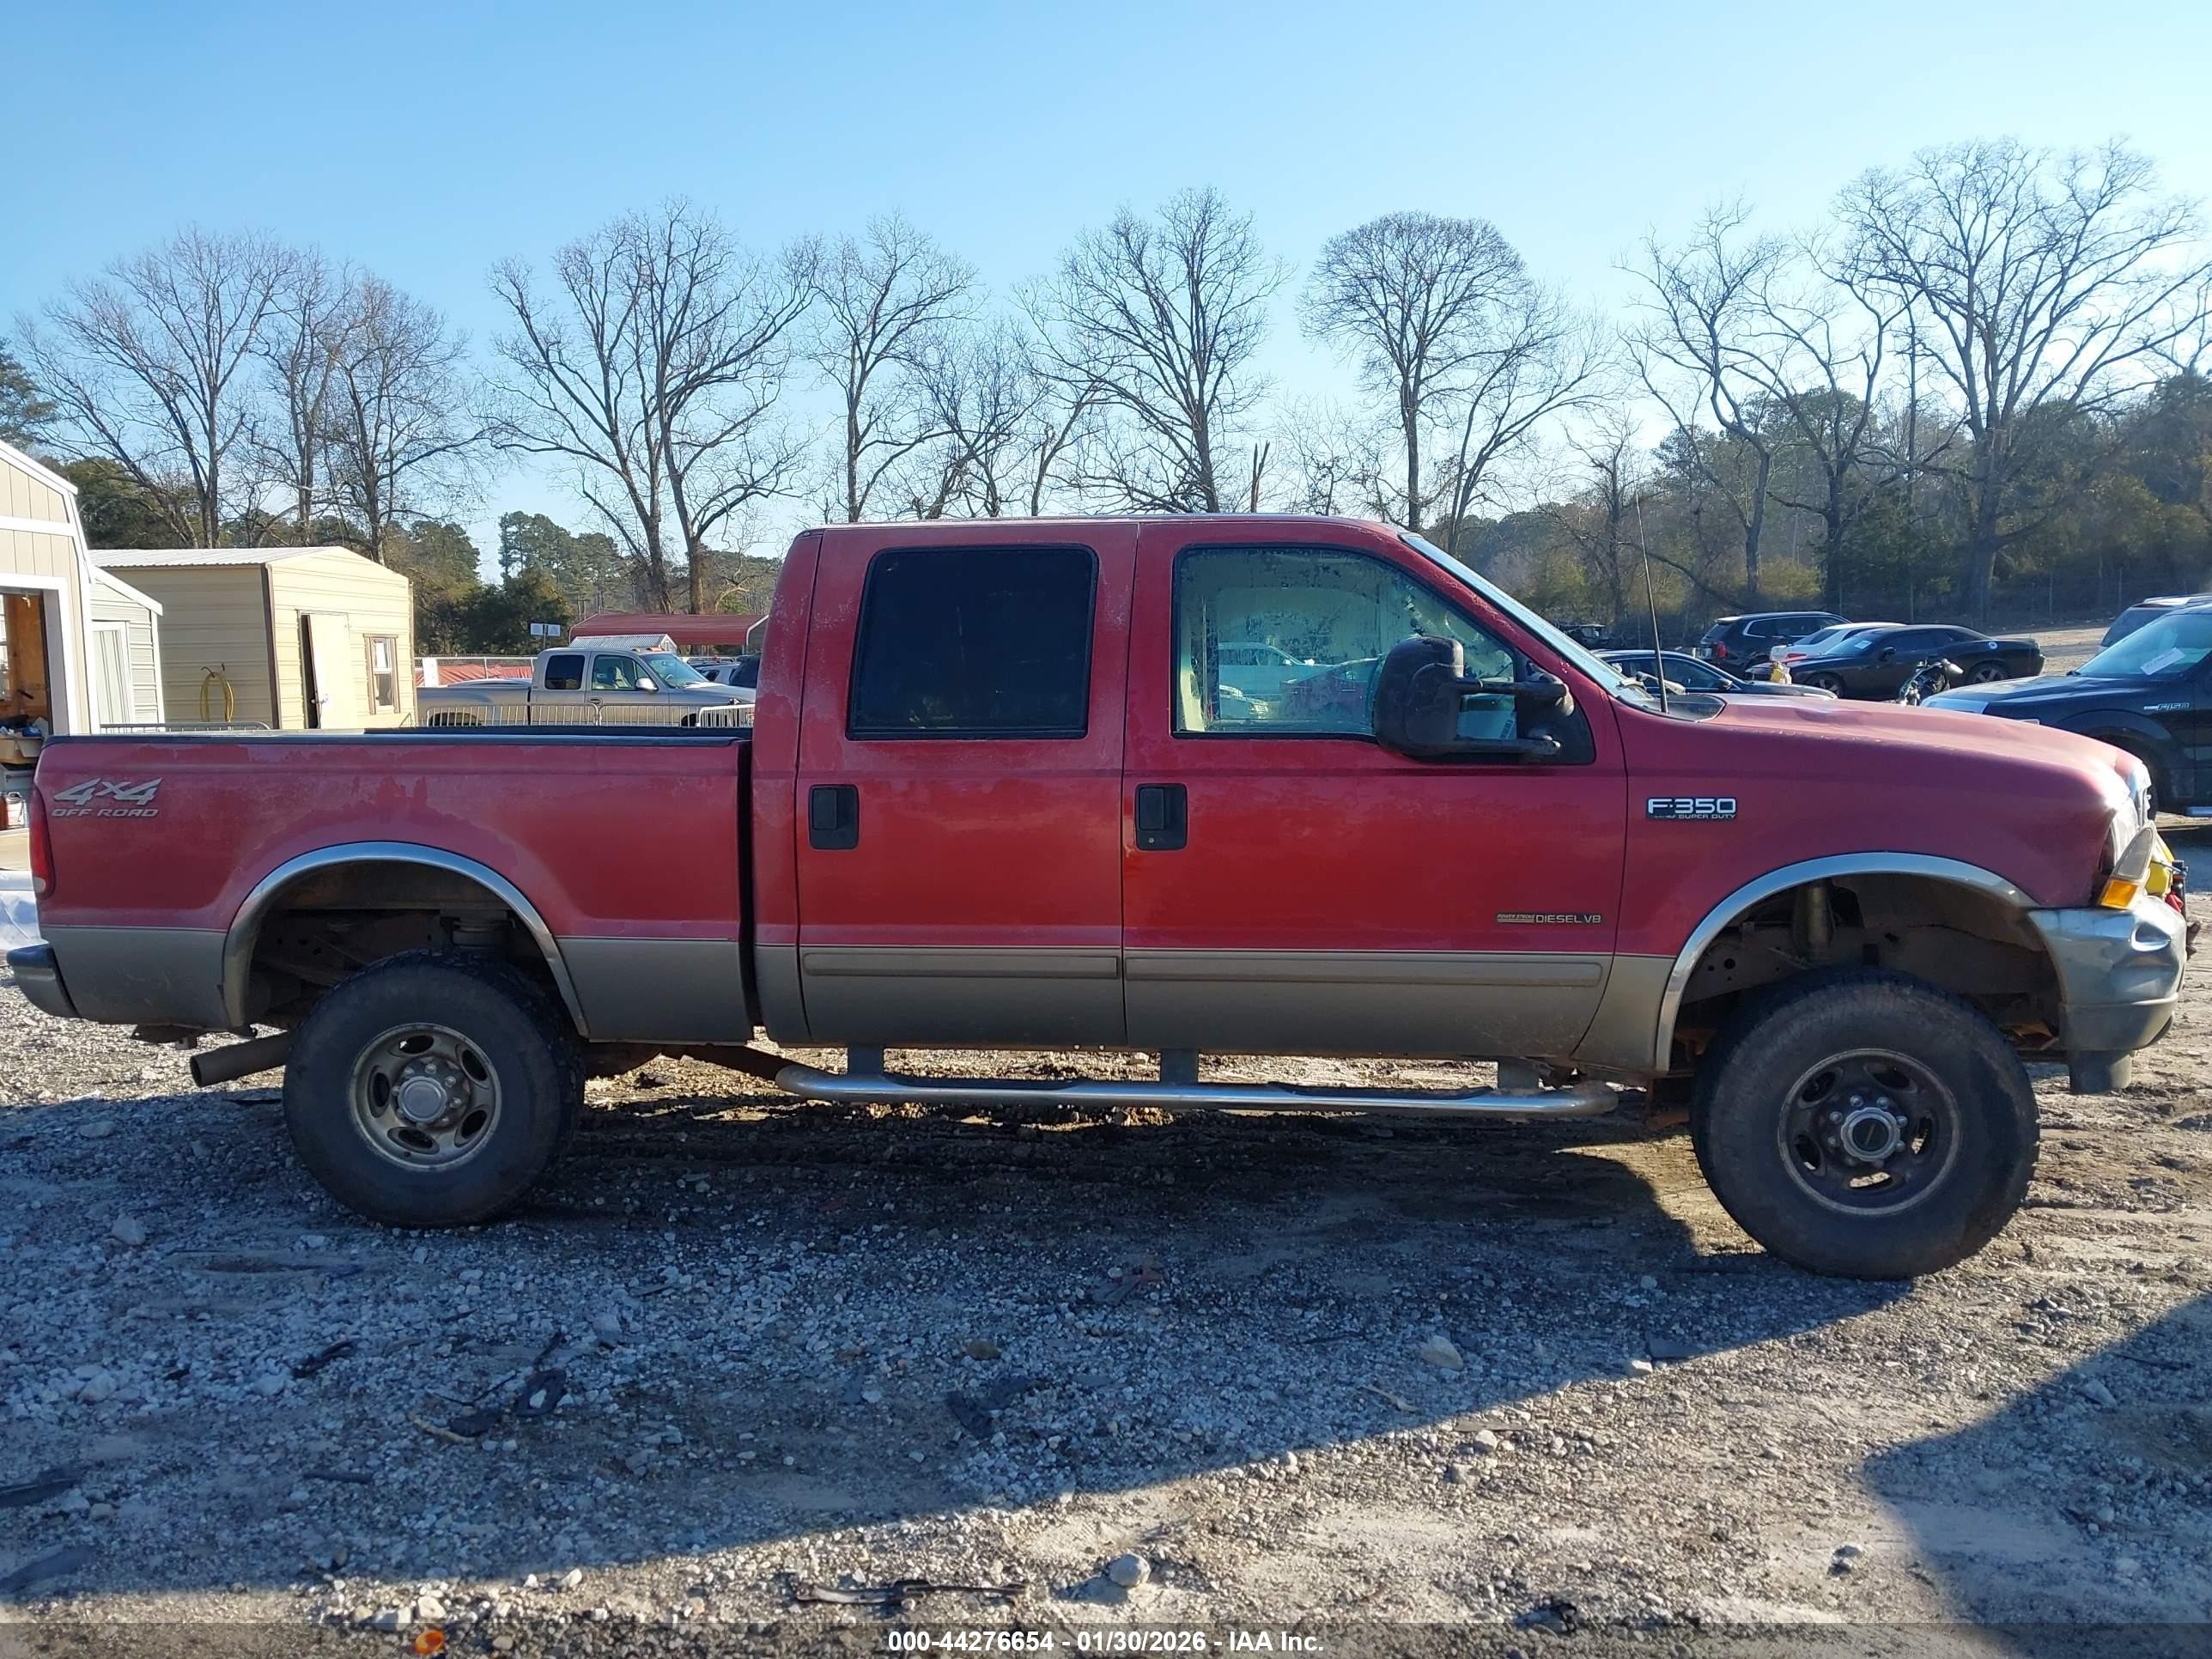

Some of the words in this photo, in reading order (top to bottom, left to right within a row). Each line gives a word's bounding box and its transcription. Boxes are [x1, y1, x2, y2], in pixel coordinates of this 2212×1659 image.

[52, 808, 93, 817] OFF
[96, 808, 159, 817] ROAD
[1535, 915, 1582, 923] DIESEL
[1583, 915, 1601, 923] V8
